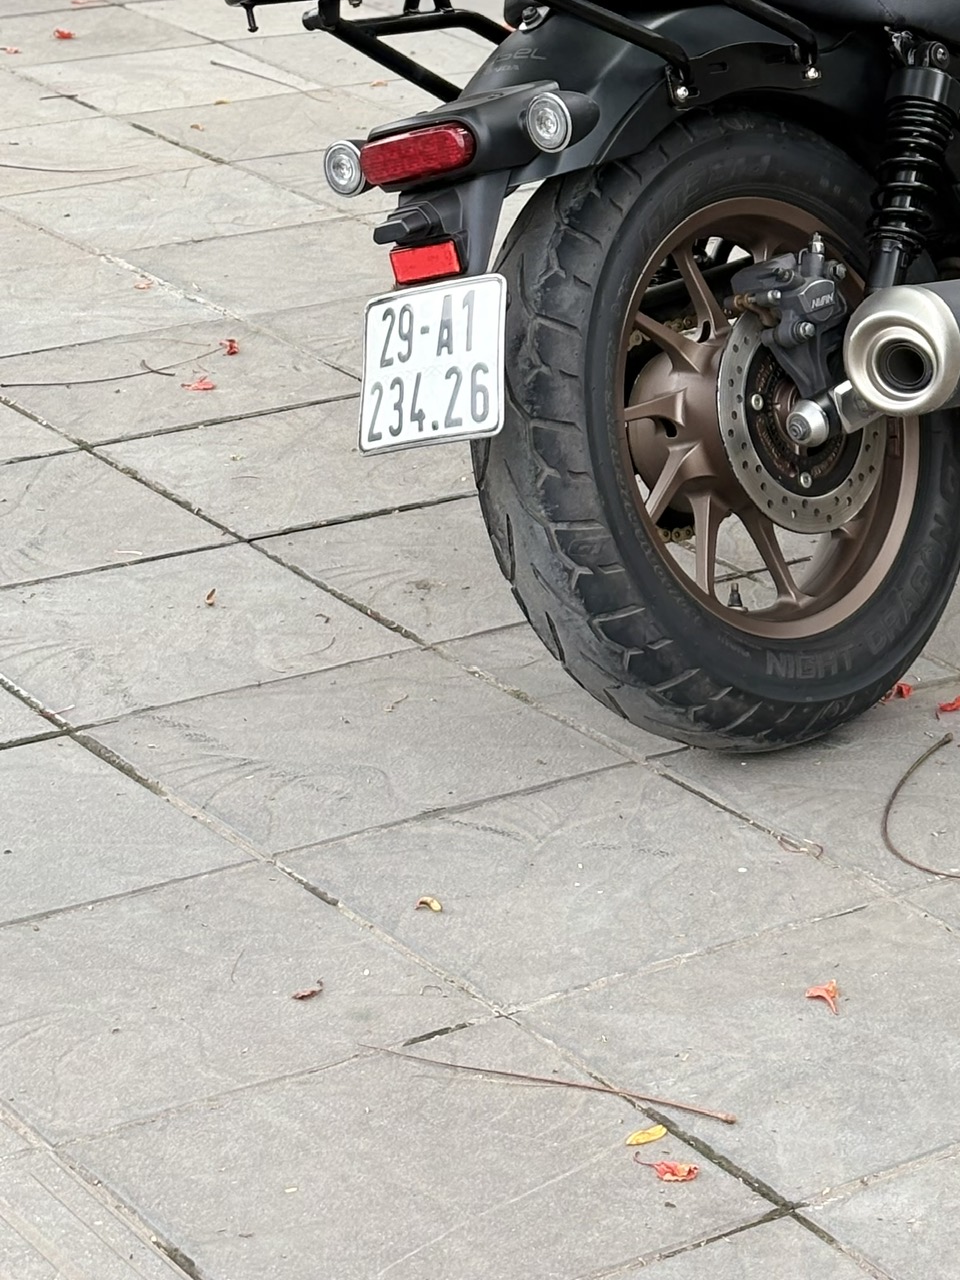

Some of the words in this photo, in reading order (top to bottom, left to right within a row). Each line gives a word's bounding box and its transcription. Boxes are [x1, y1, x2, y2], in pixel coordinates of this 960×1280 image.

[379, 290, 476, 369] 29-A1
[367, 361, 490, 443] 234.26
[765, 643, 858, 680] NIGHT
